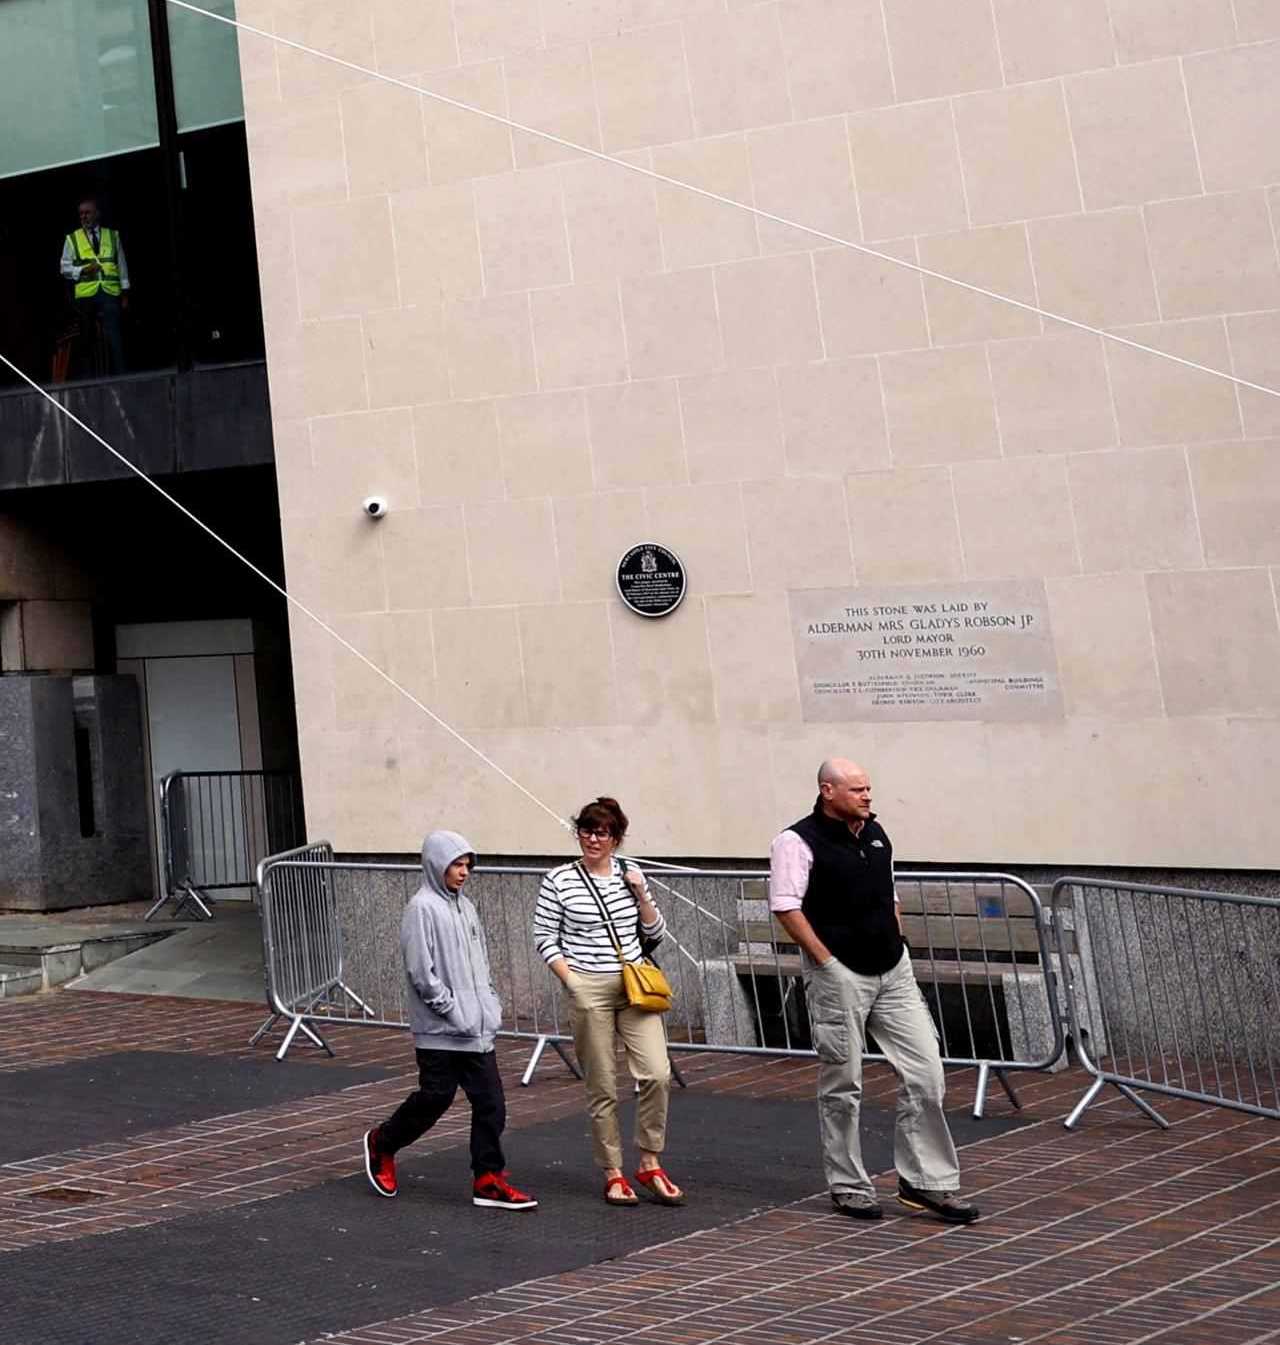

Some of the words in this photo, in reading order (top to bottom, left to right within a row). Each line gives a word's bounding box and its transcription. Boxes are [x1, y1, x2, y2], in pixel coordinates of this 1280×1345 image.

[845, 607, 869, 617] THIS
[873, 606, 907, 616] STONE
[912, 604, 937, 614] WAS
[941, 603, 968, 613] LAID
[974, 602, 989, 611] BY
[807, 621, 873, 634] ALDERMAN
[878, 620, 904, 631] MRS
[909, 617, 961, 630] GLADYS
[964, 615, 1016, 628] ROBSON
[1020, 614, 1034, 629] JP
[883, 635, 912, 645] LORD
[916, 633, 954, 643] MAYOR
[857, 649, 886, 661] 30TH
[890, 647, 953, 658] NOVEMBER
[958, 645, 986, 657] 1960
